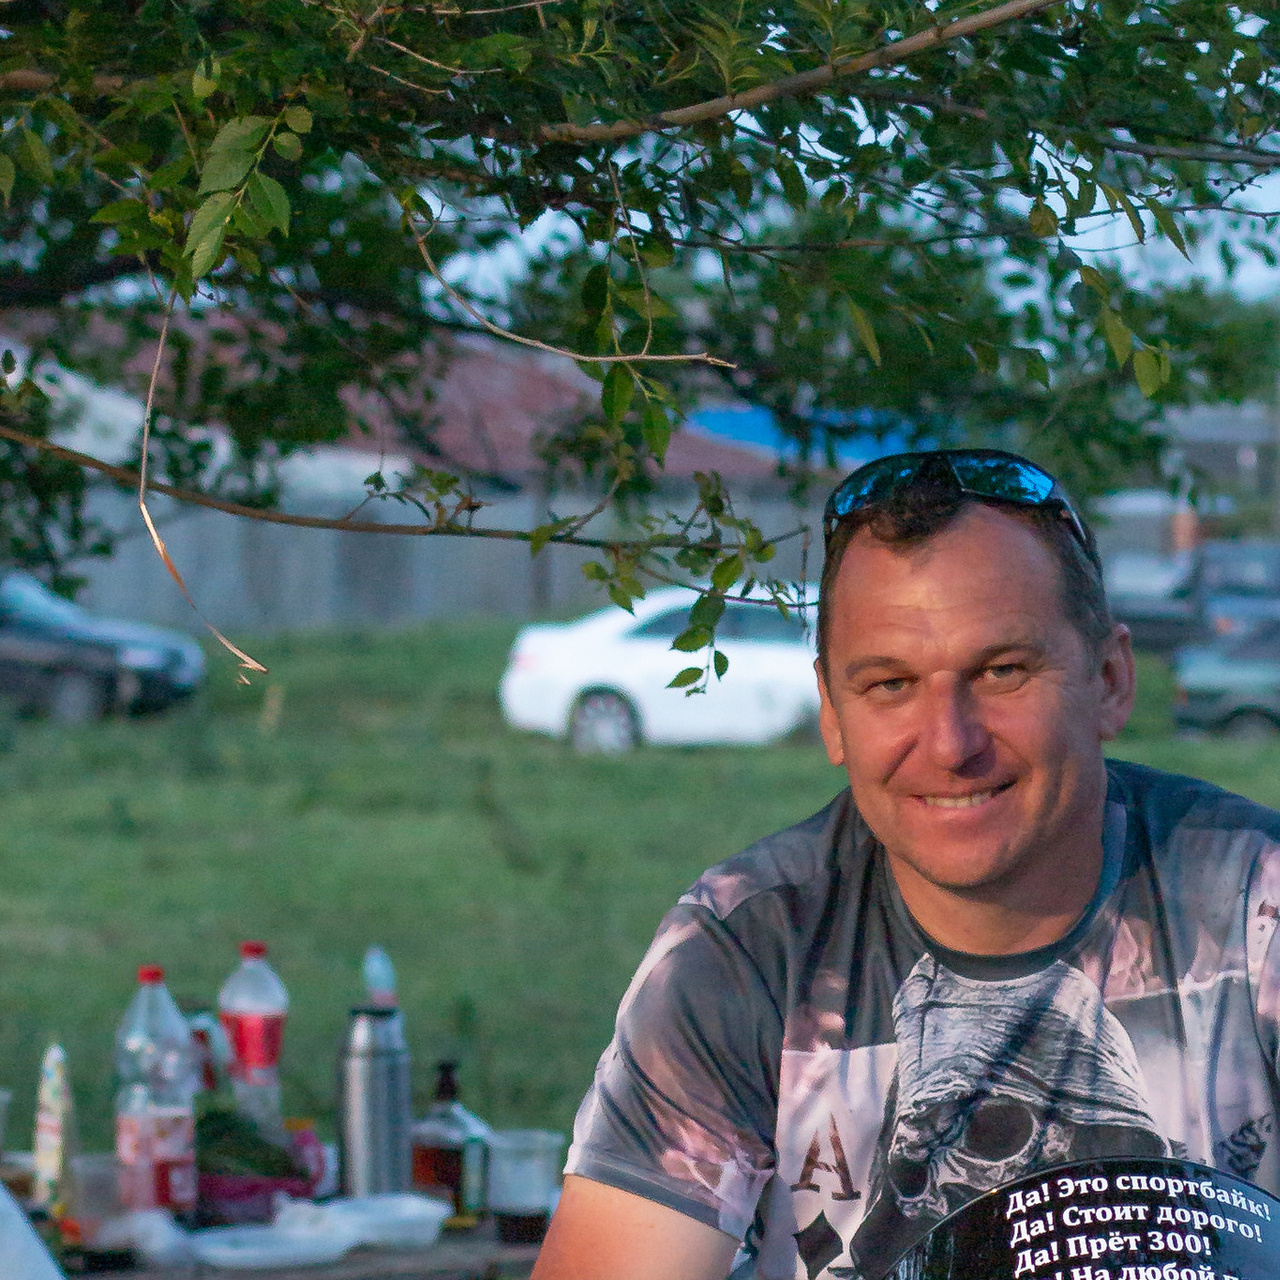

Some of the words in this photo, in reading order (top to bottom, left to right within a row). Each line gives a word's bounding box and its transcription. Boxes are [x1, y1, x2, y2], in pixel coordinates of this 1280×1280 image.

[1006, 1182, 1050, 1219] Да!
[1057, 1177, 1108, 1198] Это
[1116, 1175, 1271, 1221] спортбайк!
[1010, 1212, 1054, 1248] Да!
[1062, 1205, 1149, 1226] Стоит
[1157, 1205, 1262, 1243] дорого!
[1015, 1241, 1059, 1279] Да!
[1066, 1231, 1141, 1259] Прёт
[1148, 1231, 1212, 1256] 300!
